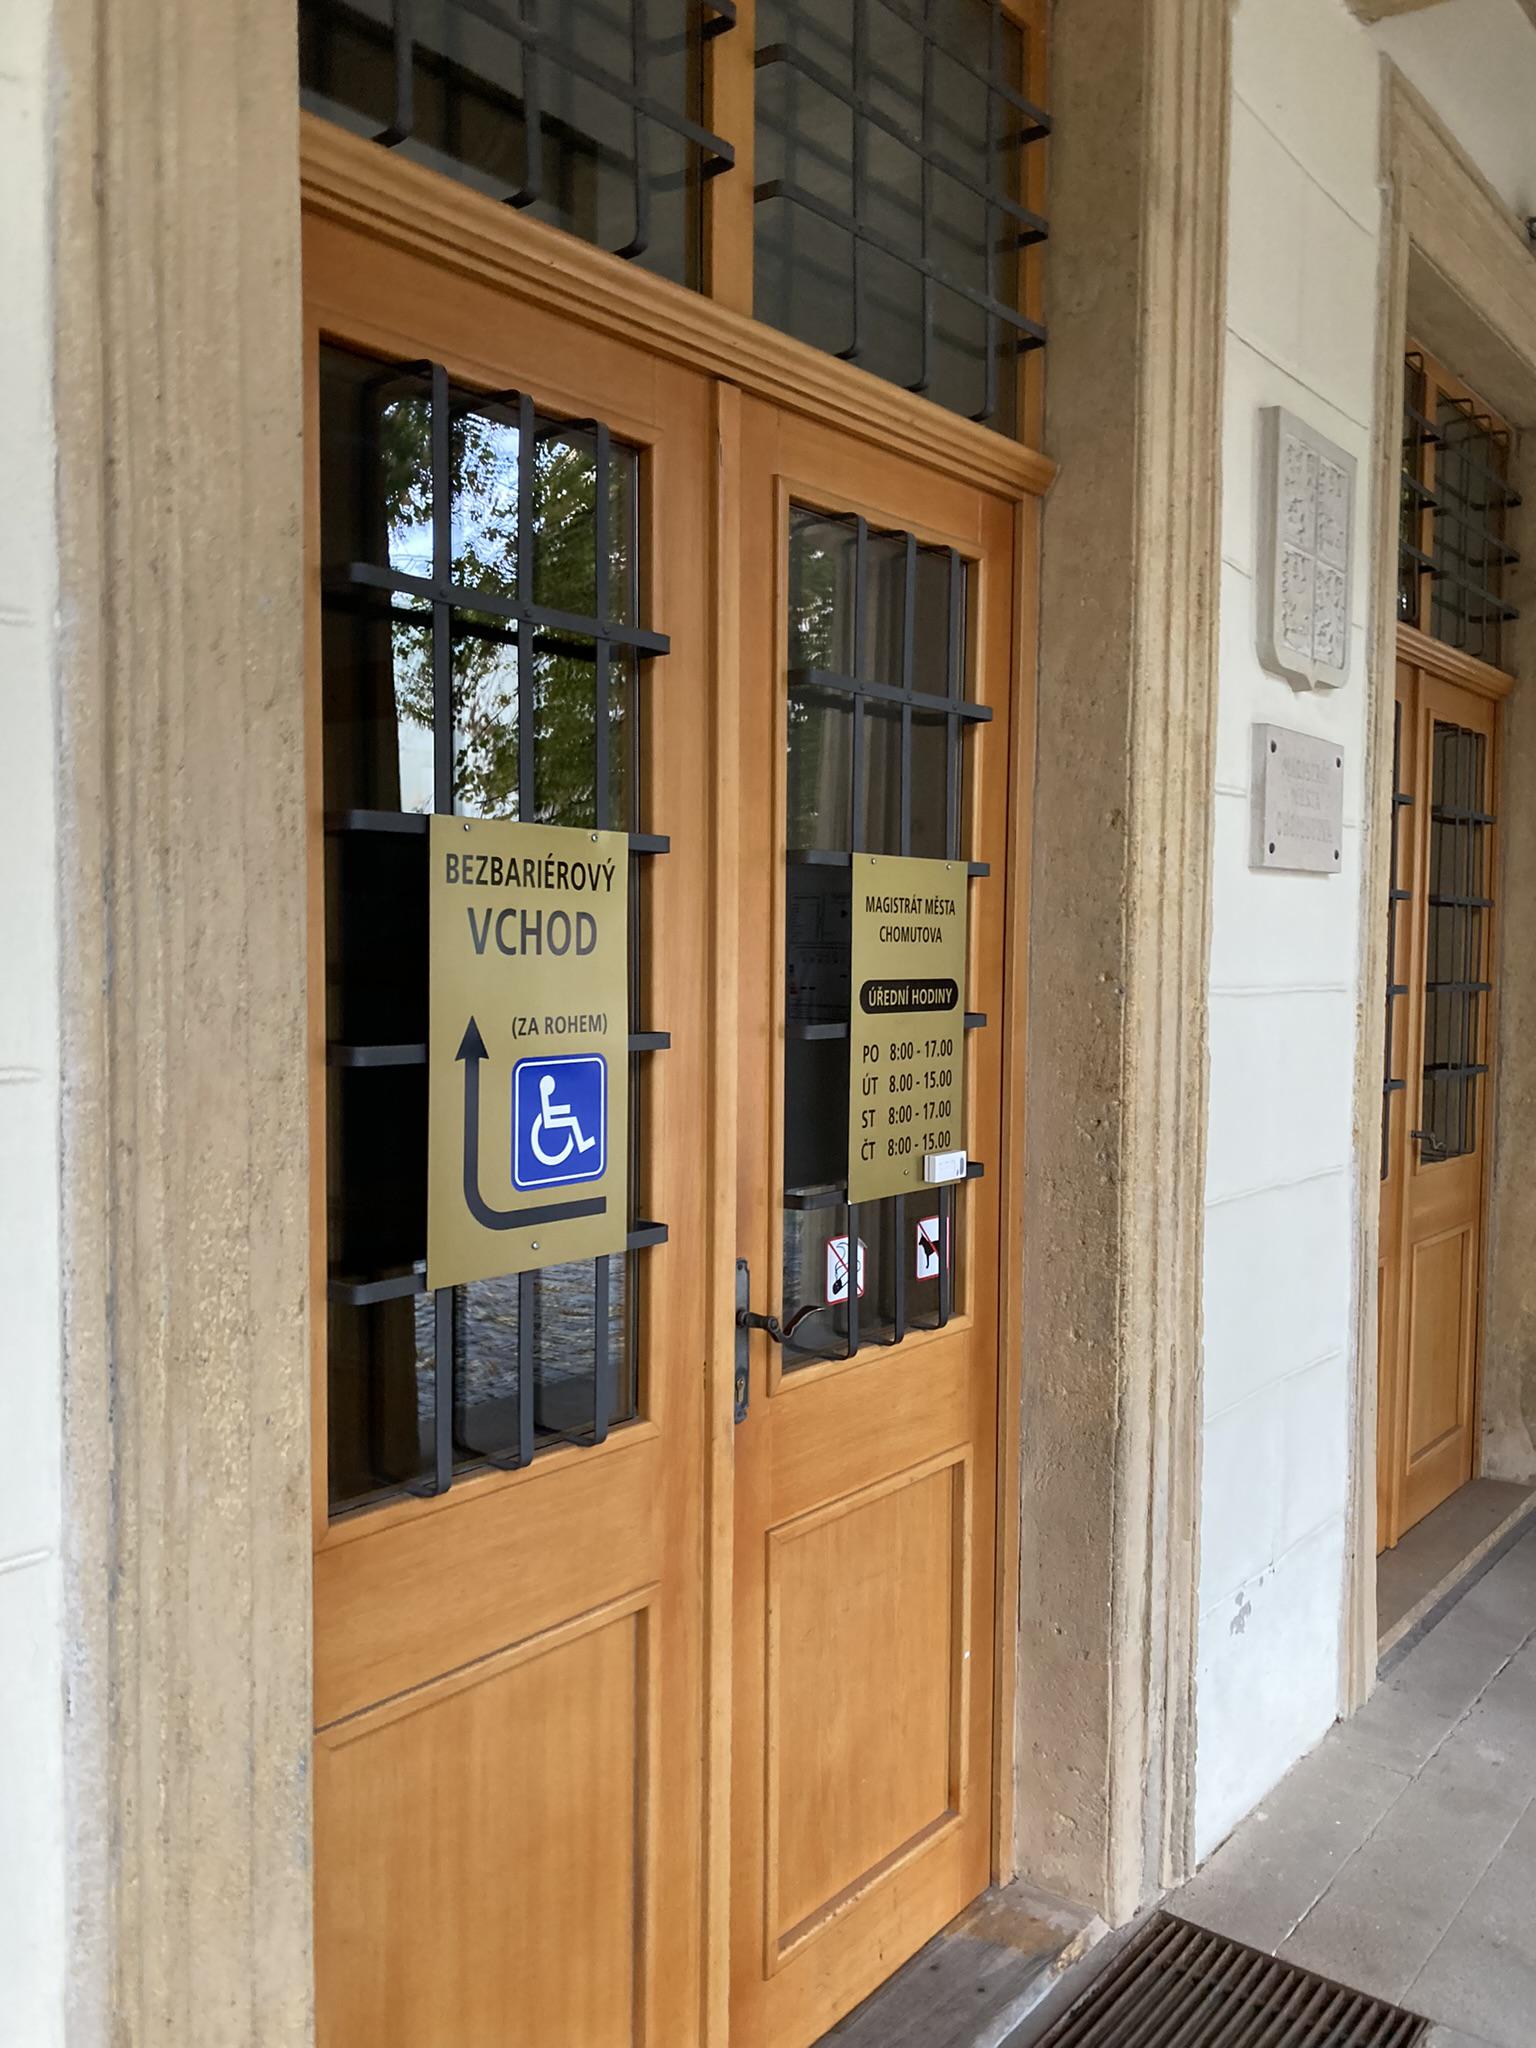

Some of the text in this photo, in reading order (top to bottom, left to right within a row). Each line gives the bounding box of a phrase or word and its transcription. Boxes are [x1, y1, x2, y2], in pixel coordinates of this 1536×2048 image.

[446, 853, 615, 892] BEZBARIÉROVÝ
[866, 895, 955, 916] MAGISTRÁT MĚSTA
[467, 907, 597, 956] VCHOD
[880, 926, 942, 943] CHOMUTOVA
[868, 986, 952, 1007] ÚŘEDNÍ HODINY
[512, 1013, 608, 1039] (ZA ROHEM)
[863, 1044, 879, 1063] PO
[890, 1042, 914, 1061] 8:00
[925, 1039, 953, 1058] 17.00
[863, 1073, 878, 1096] ÚT
[889, 1073, 913, 1093] 8.00
[924, 1069, 952, 1089] 15.00
[862, 1109, 876, 1128] ST
[888, 1105, 912, 1125] 8:00
[923, 1100, 951, 1120] 17.00
[861, 1139, 876, 1161] ČT
[888, 1136, 911, 1157] 8:00
[923, 1130, 951, 1151] 15.00
